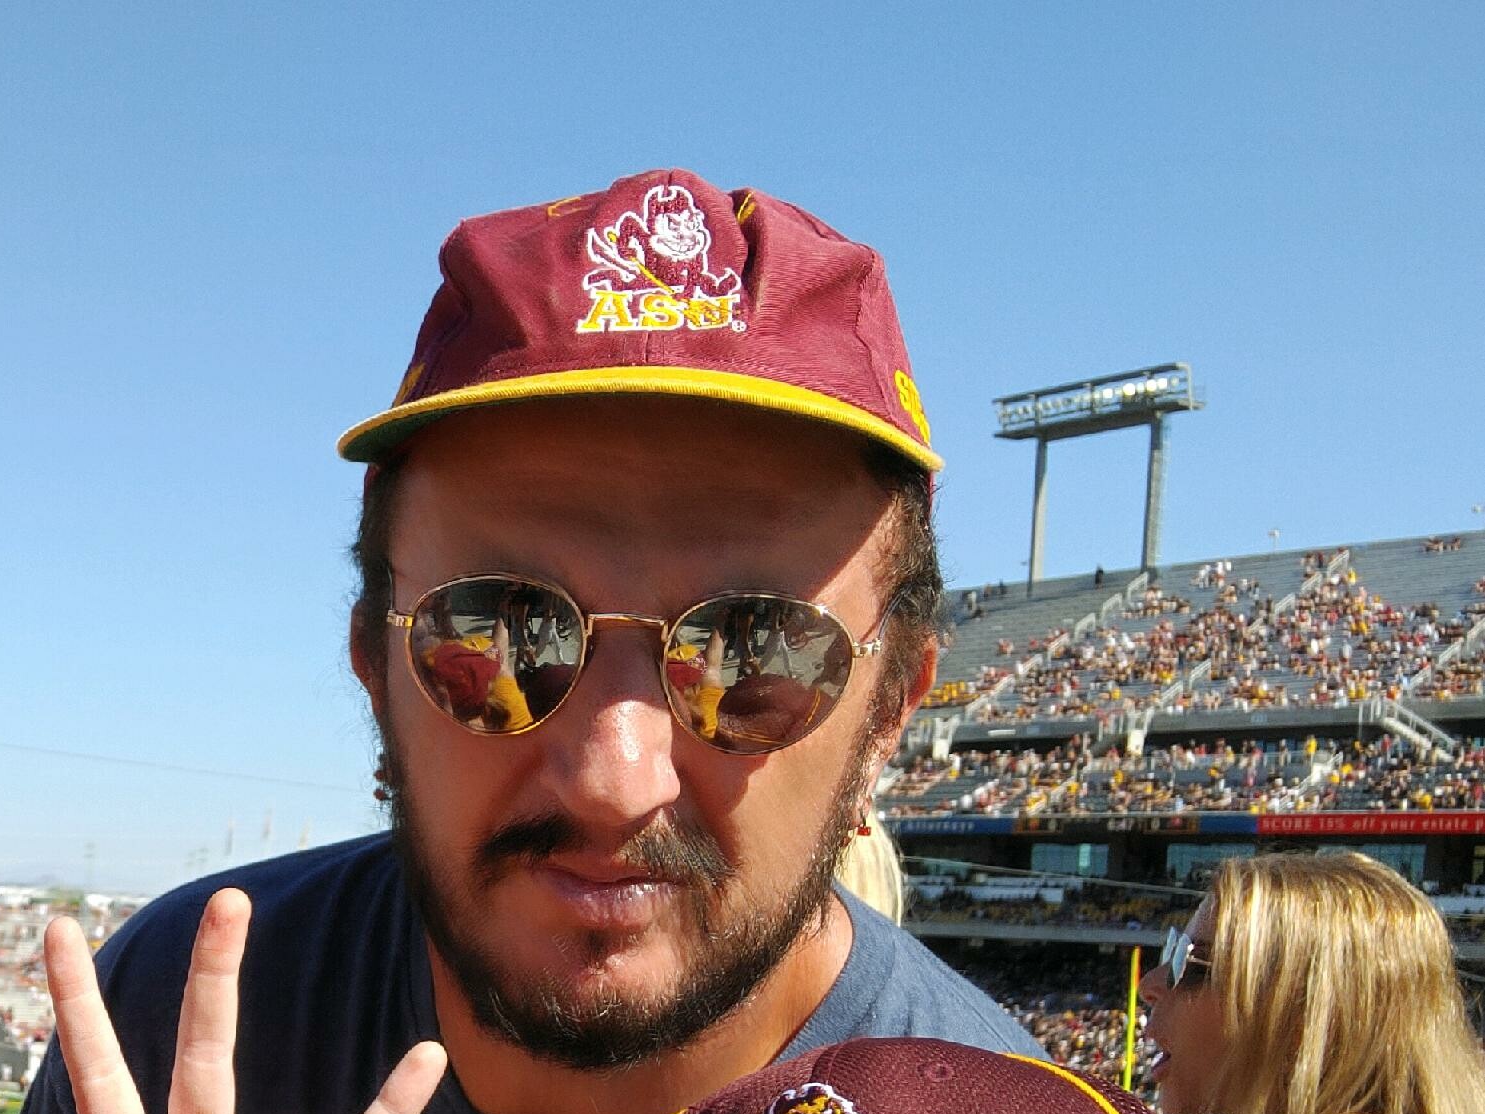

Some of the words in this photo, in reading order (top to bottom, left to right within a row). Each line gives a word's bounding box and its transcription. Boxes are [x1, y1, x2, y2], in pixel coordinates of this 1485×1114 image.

[577, 288, 742, 333] ASU
[1262, 816, 1312, 831] SCORE
[1319, 816, 1347, 831] 15%
[1353, 816, 1376, 831] off
[1380, 817, 1416, 833] your
[1421, 816, 1468, 832] estate
